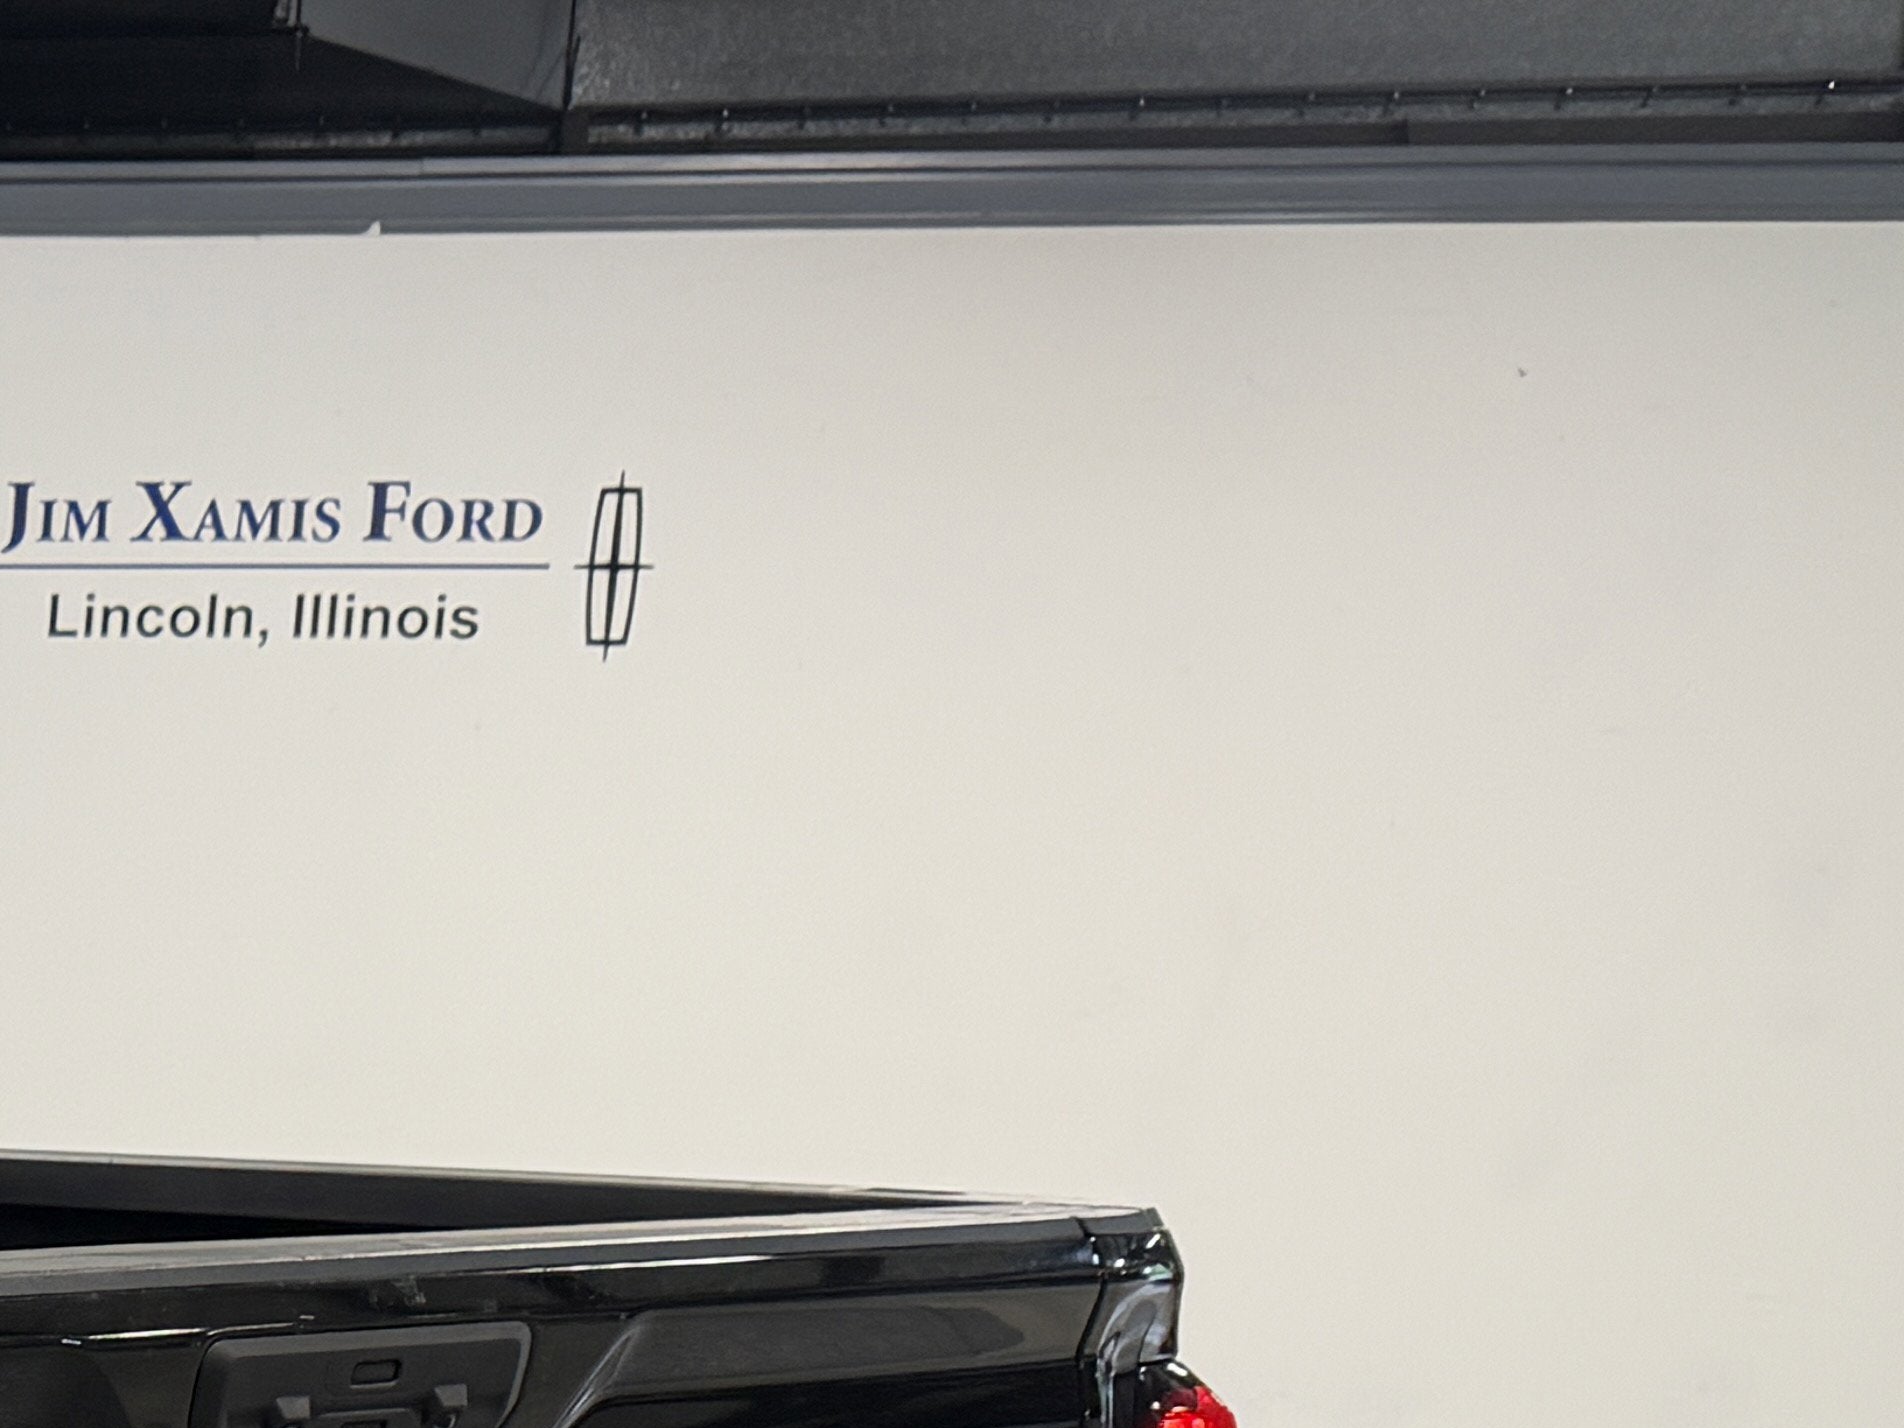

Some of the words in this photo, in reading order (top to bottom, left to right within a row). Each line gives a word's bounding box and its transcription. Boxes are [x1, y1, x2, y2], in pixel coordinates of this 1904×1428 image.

[0, 480, 113, 554] JIM
[128, 479, 342, 544] XAMIS
[362, 480, 544, 544] FORD
[46, 591, 270, 648] Lincoln,
[292, 591, 480, 640] Illinois
